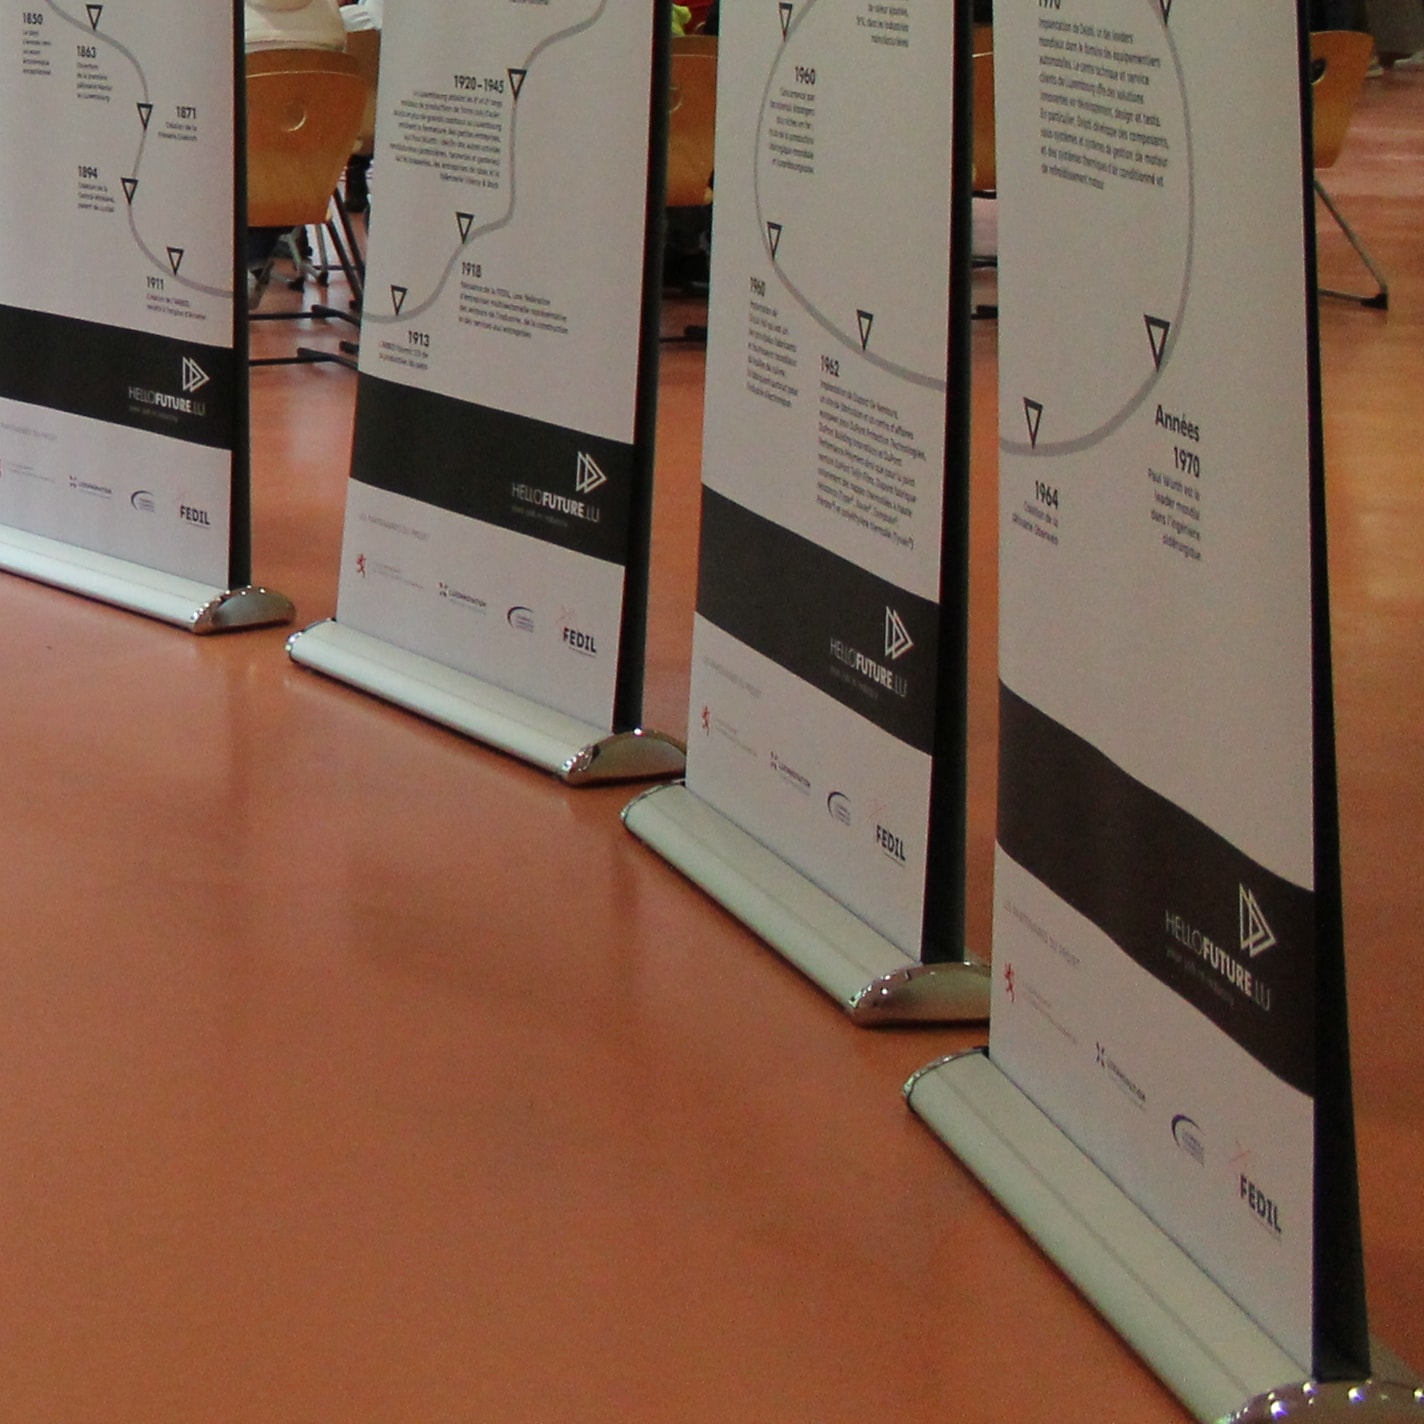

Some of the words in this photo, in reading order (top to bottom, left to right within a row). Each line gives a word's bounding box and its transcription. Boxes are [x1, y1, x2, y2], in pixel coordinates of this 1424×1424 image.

[23, 12, 44, 25] 1850
[77, 45, 97, 59] 1863
[795, 65, 816, 85] 1960
[176, 105, 197, 120] 1871
[78, 165, 98, 179] 1894
[461, 261, 482, 278] 1918
[146, 276, 165, 290] 1911
[407, 330, 431, 348] 1913
[1155, 404, 1200, 443] Années
[1174, 446, 1200, 478] 1970
[1035, 479, 1059, 511] 1964
[179, 504, 211, 526] FEDIL
[563, 627, 598, 654] FEDIL
[876, 824, 907, 862] FEDIL
[1238, 1173, 1283, 1235] FEDIL
